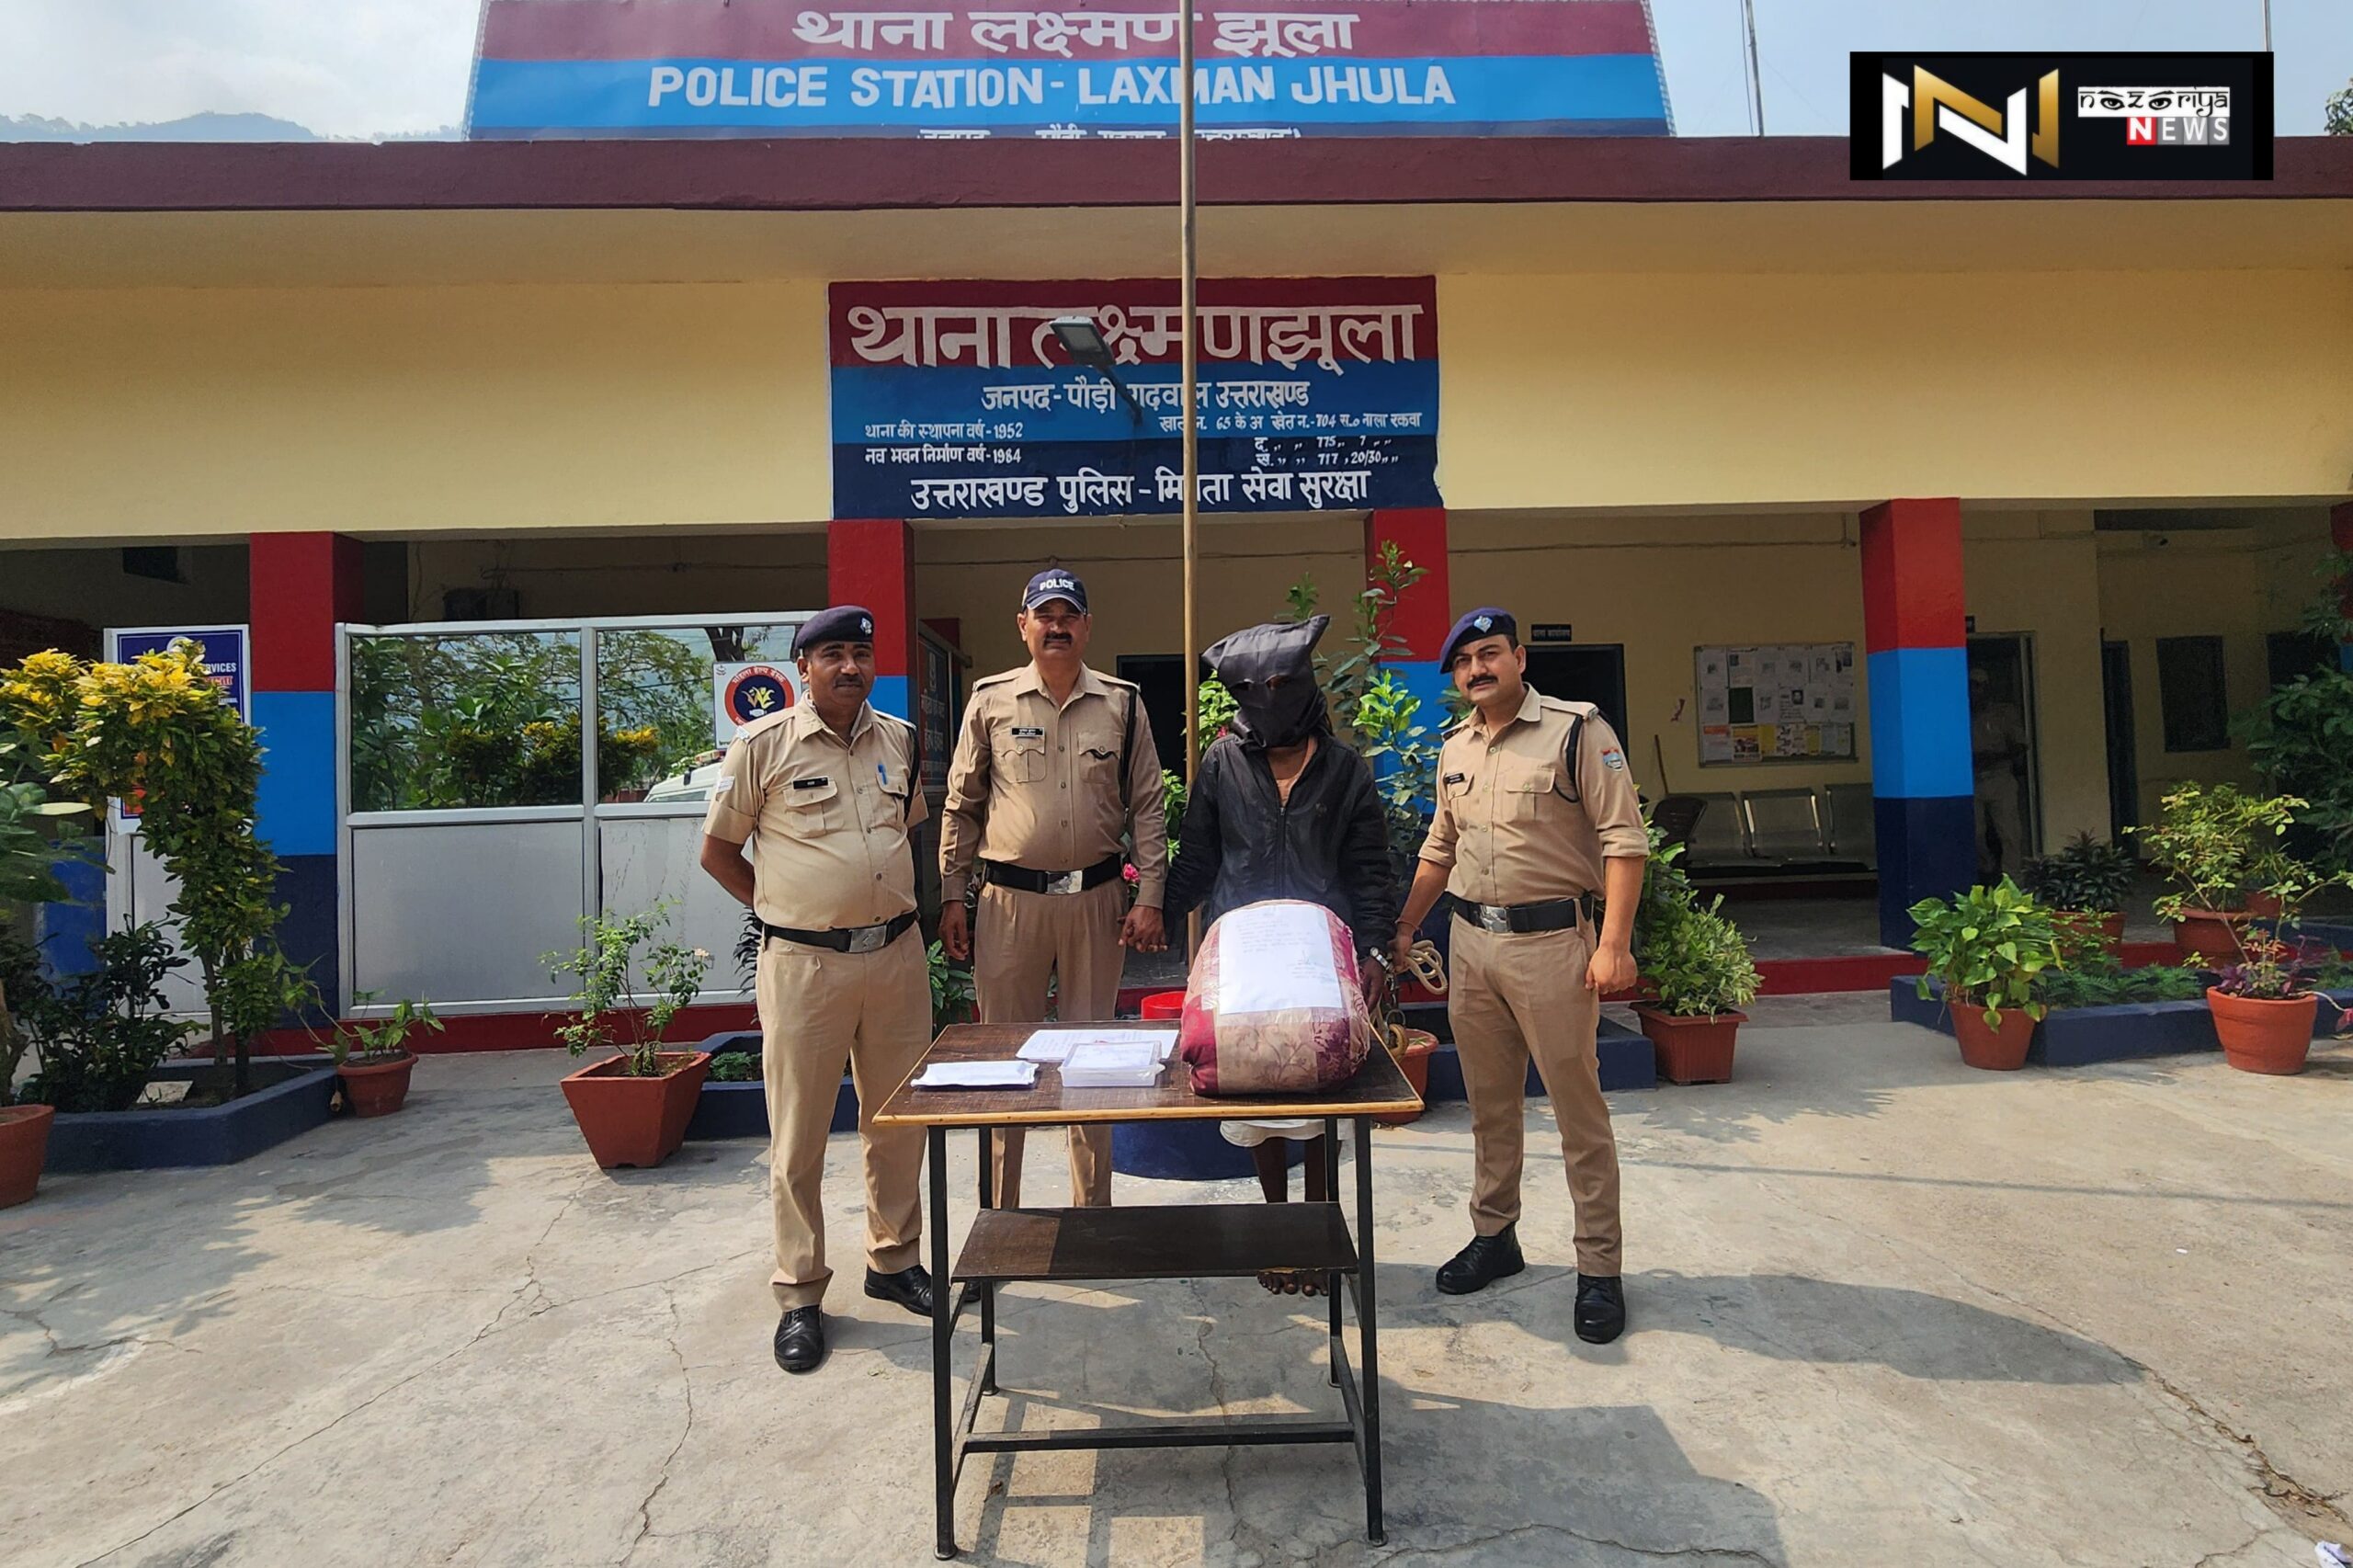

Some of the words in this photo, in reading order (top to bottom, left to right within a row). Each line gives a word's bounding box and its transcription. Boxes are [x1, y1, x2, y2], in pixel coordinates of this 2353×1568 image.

[793, 11, 952, 51] थाना
[1212, 13, 1360, 57] झूला
[647, 66, 827, 108] POLICE
[1291, 64, 1456, 105] JHULA
[865, 423, 896, 439] थाना
[897, 419, 916, 439] की
[918, 423, 964, 440] स्थापना
[865, 448, 888, 464] नव
[891, 448, 920, 464] भवन
[921, 442, 965, 463] निर्माण
[911, 477, 1049, 510] उत्तराखण्ड
[1242, 466, 1294, 503] सेवा
[1299, 471, 1371, 508] सुरक्षा
[1040, 578, 1074, 590] POLICE
